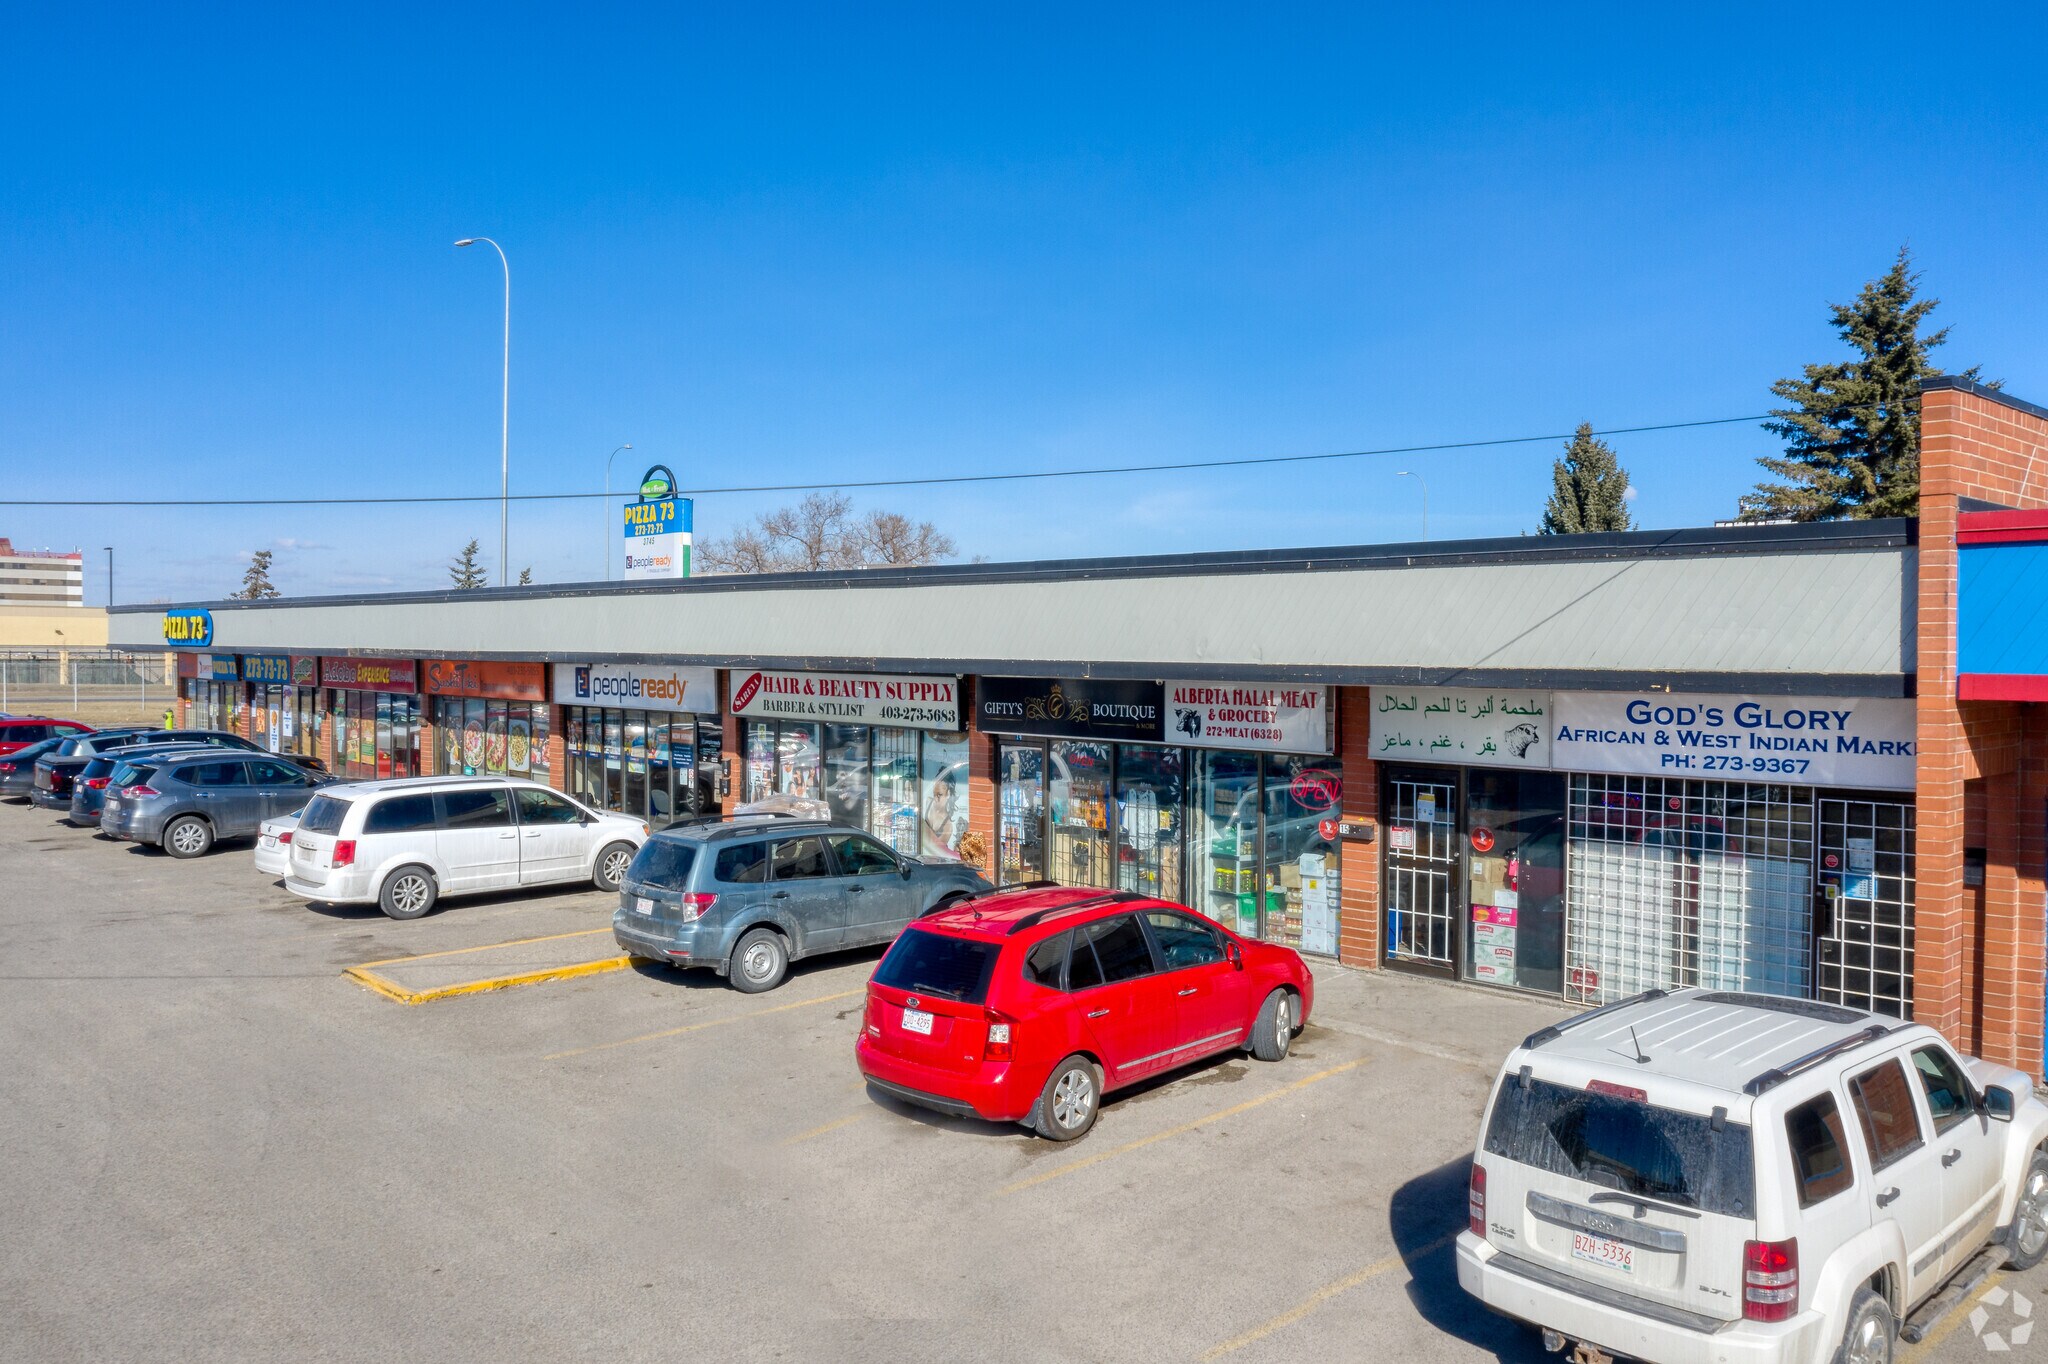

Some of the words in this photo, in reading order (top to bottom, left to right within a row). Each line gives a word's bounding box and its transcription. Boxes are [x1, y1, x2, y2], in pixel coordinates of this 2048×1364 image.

[625, 504, 657, 525] PIZZA
[660, 502, 675, 521] 73
[635, 523, 664, 536] 273-73-73
[633, 554, 672, 570] peopleready
[163, 616, 188, 639] PIZZA
[189, 616, 204, 639] 73
[245, 657, 288, 681] 273-73-73
[323, 661, 357, 683] Adobo
[593, 671, 687, 705] peopleready
[763, 676, 800, 695] HAIR
[803, 679, 815, 695] &
[818, 678, 883, 699] BEAUTY
[886, 682, 955, 703] SUPPLY
[1173, 687, 1228, 705] ALBERTA
[1232, 689, 1277, 706] HALAL
[1280, 690, 1318, 709] MEAT
[763, 699, 806, 714] BARBER
[808, 702, 816, 714] &
[818, 702, 865, 717] STYLIST
[878, 705, 956, 723] 403-273-5683
[984, 701, 1023, 716] GIFTY'S
[1093, 703, 1156, 720] BOUTIQUE
[1379, 694, 1417, 713] الحلال
[1424, 696, 1450, 718] للحم
[1500, 698, 1543, 716] ملحمة
[1208, 709, 1216, 721] &
[1218, 708, 1278, 724] GROCERY
[1626, 700, 1724, 728] GOD'S
[1734, 702, 1853, 731] GLORY
[1557, 726, 1646, 745] AFRICAN
[1654, 730, 1670, 746] &
[1676, 730, 1742, 748] WEST
[1749, 732, 1829, 753] INDIAN
[1661, 753, 1697, 770] PH:
[1703, 756, 1811, 775] 273-9367
[1292, 777, 1339, 801] OPEN
[1575, 1234, 1632, 1265] BZH-5336
